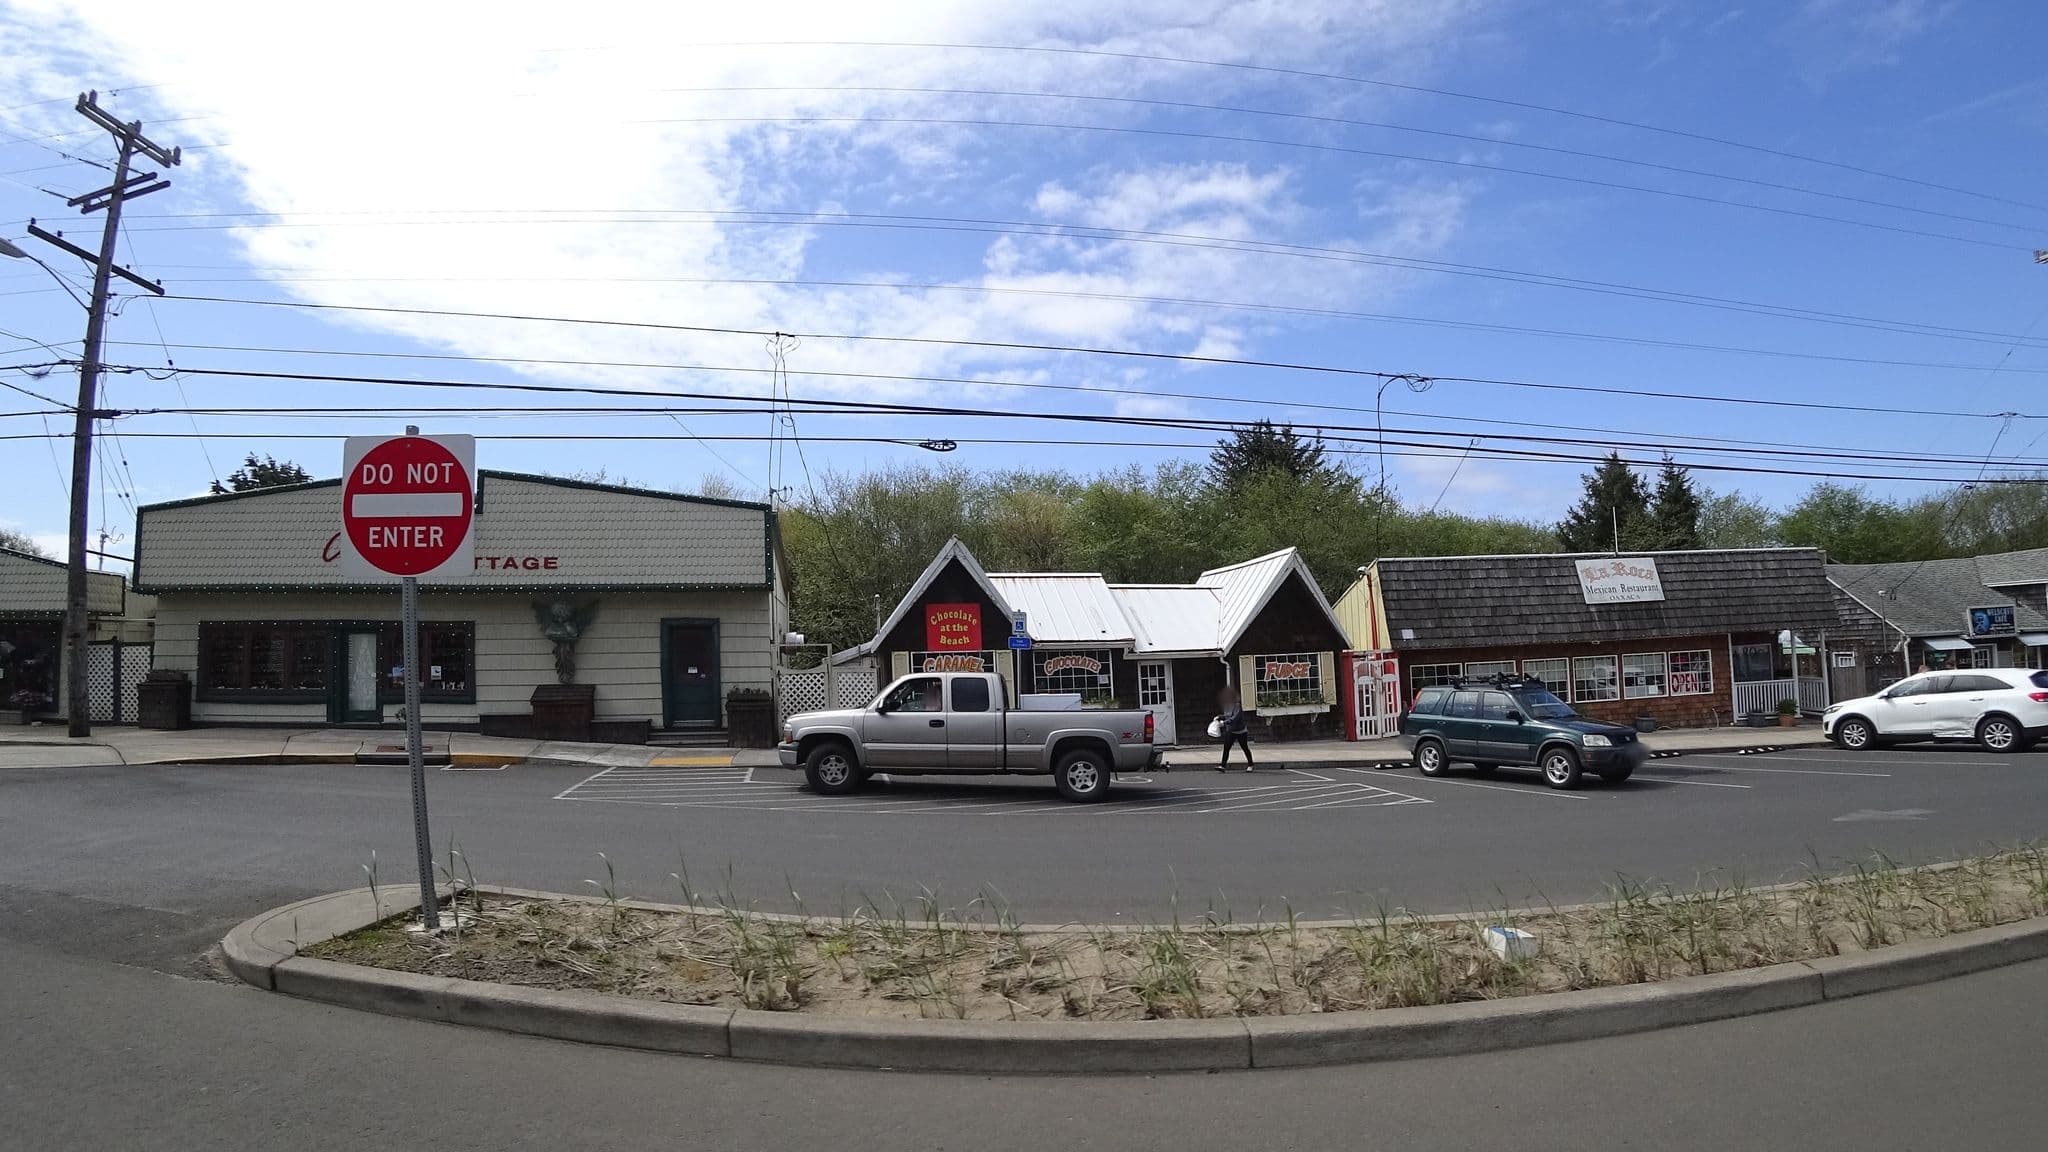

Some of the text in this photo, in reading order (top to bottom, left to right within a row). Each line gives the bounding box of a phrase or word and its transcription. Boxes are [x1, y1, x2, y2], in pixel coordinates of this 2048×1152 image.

[362, 462, 454, 485] DO NOT
[368, 526, 444, 548] ENTER
[1582, 561, 1655, 583] La Roca
[1585, 583, 1660, 595] Mexican Restaurant
[930, 609, 977, 626] Chocolate
[951, 623, 969, 632] the
[940, 635, 971, 645] Beach
[923, 655, 984, 672] CARAMEL
[1044, 655, 1101, 676] CHOCOLATES
[1264, 662, 1311, 681] FUDGE
[1671, 672, 1699, 693] OPEN
